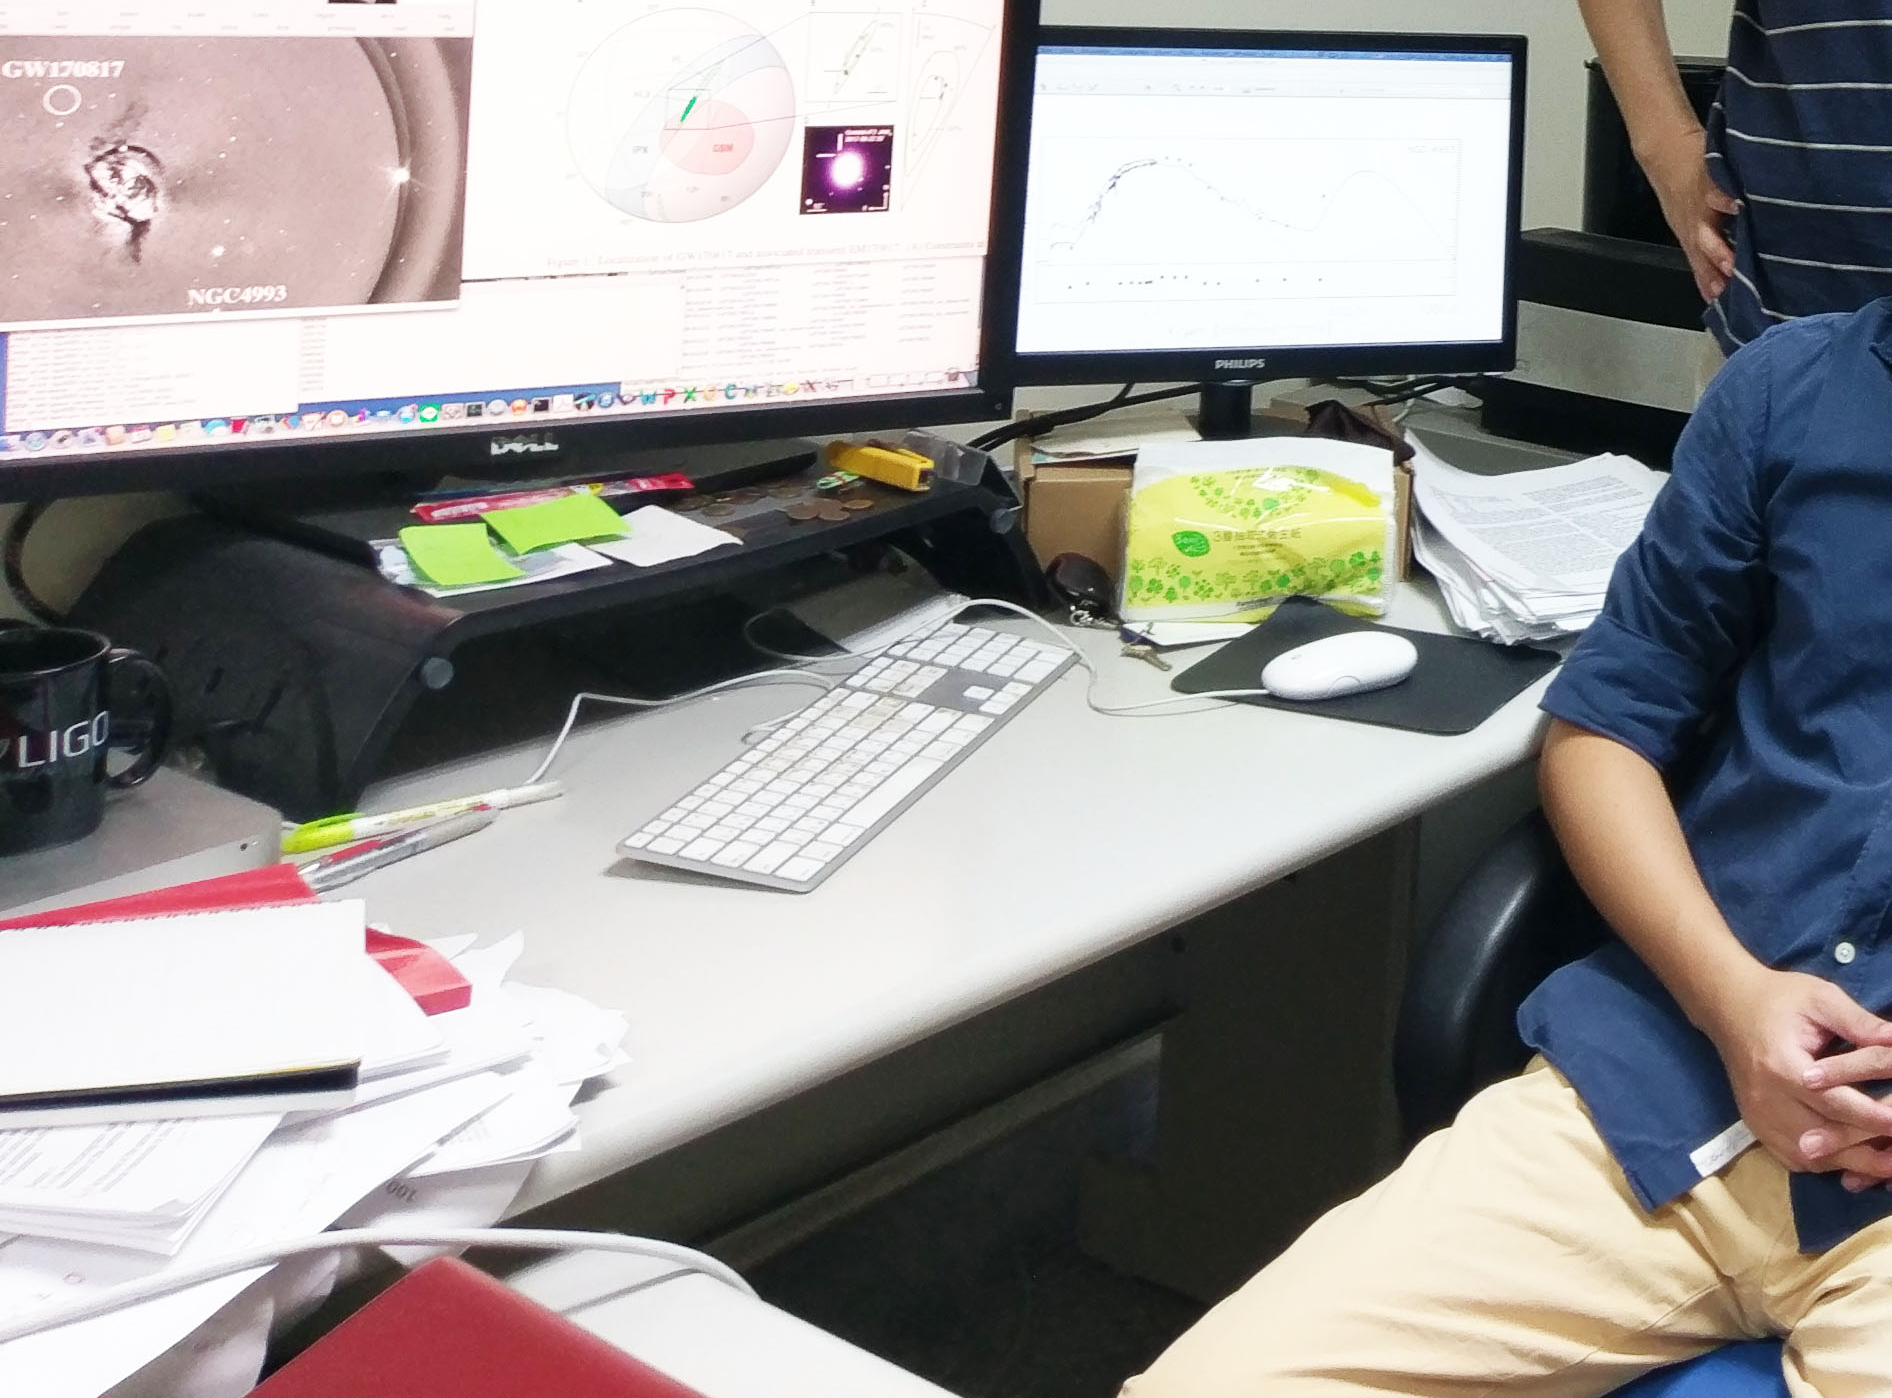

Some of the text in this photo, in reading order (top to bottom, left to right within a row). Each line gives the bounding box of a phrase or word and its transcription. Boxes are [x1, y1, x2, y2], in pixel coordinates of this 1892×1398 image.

[1, 60, 125, 79] GW170817
[187, 284, 287, 308] NGC4993
[1215, 358, 1266, 370] PHILIPS
[491, 433, 559, 456] DELL
[18, 710, 109, 768] LIGO
